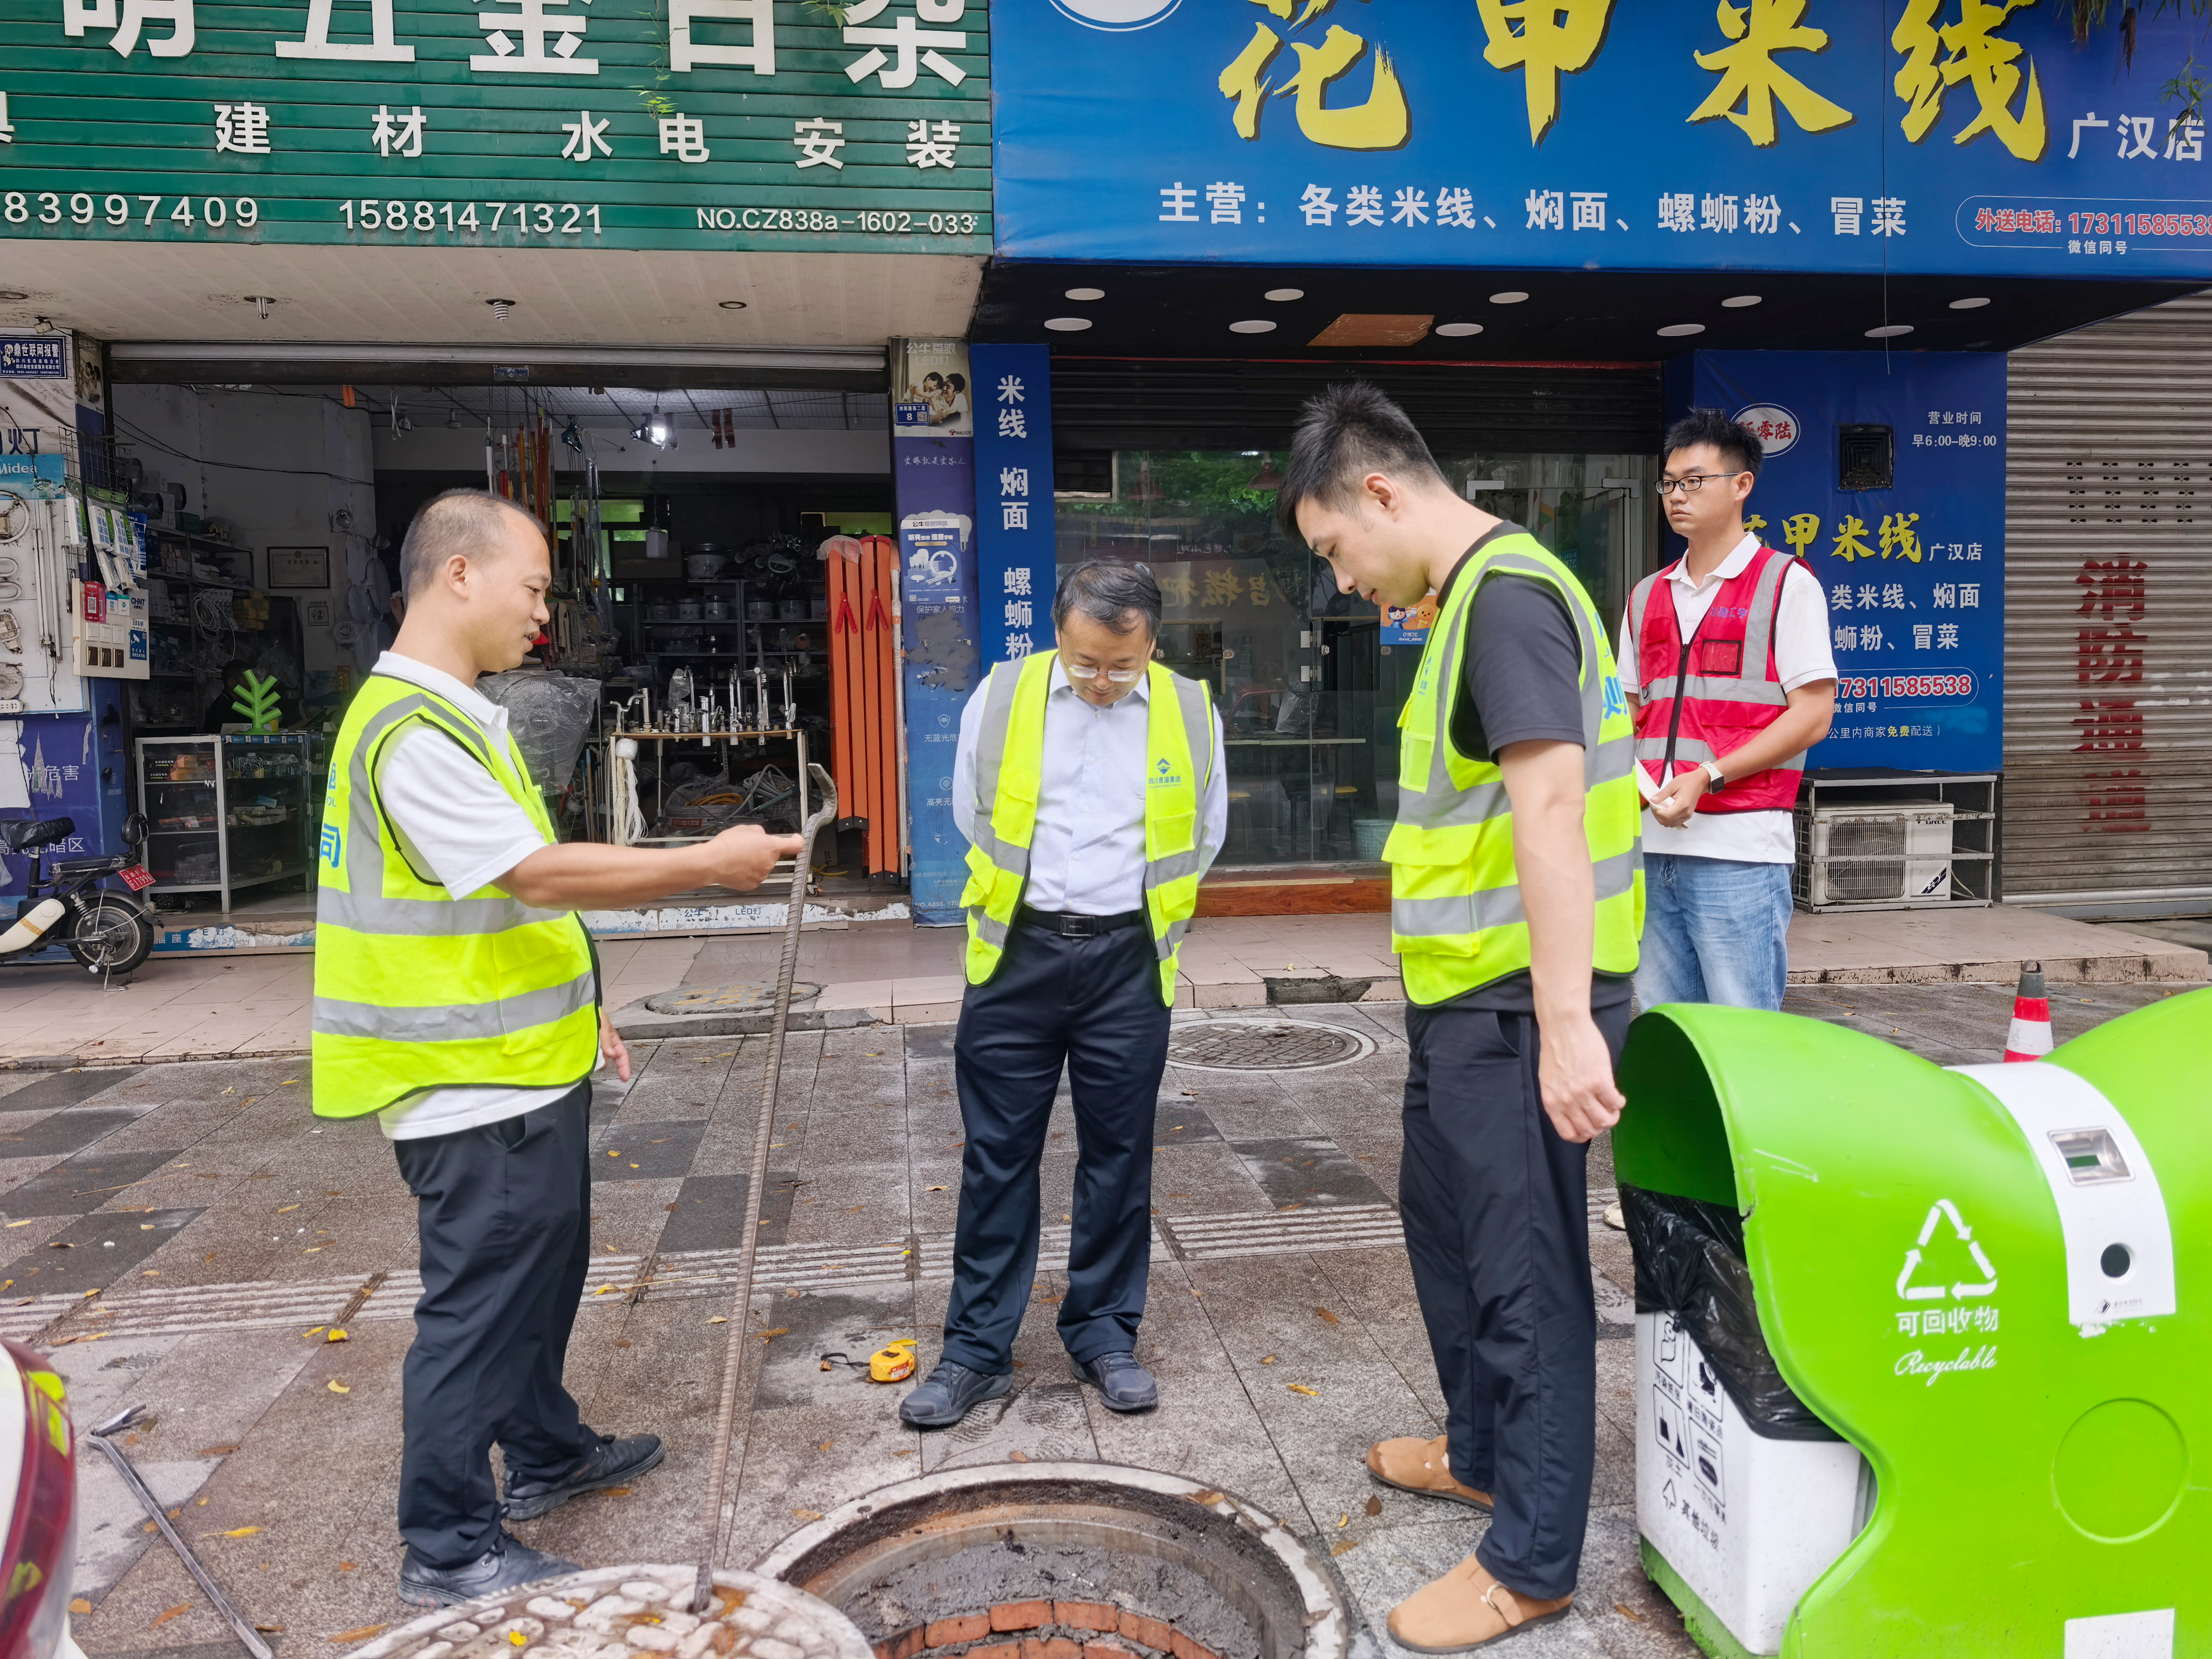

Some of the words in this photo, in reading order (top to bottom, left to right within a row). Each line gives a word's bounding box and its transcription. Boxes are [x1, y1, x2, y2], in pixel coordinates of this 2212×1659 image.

[2067, 111, 2205, 161] 广汉店
[4, 192, 258, 228] 83997409
[339, 199, 602, 234] 15881471321
[696, 208, 975, 234] NO.CZ838a-1602-033
[1158, 181, 1265, 224] 主营：
[1830, 196, 1907, 236] 冒菜
[1975, 208, 2062, 234] 外送电话:
[2068, 240, 2127, 255] 微信同号
[906, 343, 956, 354] 公牛爱眼
[915, 356, 949, 366] LED灯
[997, 375, 1027, 439] 米线
[1928, 411, 1982, 425] 营业时间
[1912, 434, 1997, 448] 早6:00-晚9:00
[904, 455, 966, 466] 爱眼就是爱家人
[1000, 468, 1029, 530] 焖面
[1929, 542, 1983, 562] 广汉店
[1823, 583, 1917, 610] 类米线、
[1933, 583, 1980, 609] 焖面
[1004, 568, 1033, 660] 螺蛳粉
[1828, 624, 1895, 652] 蛳粉、
[1912, 624, 1960, 650] 冒菜
[2070, 552, 2151, 832] 消防通道
[1833, 702, 1877, 714] 微信同号
[924, 733, 959, 743] 无蓝光危
[927, 798, 953, 807] 高亮无
[1895, 1308, 1998, 1338] 可回收物
[1895, 1345, 1998, 1387] Recyclable
